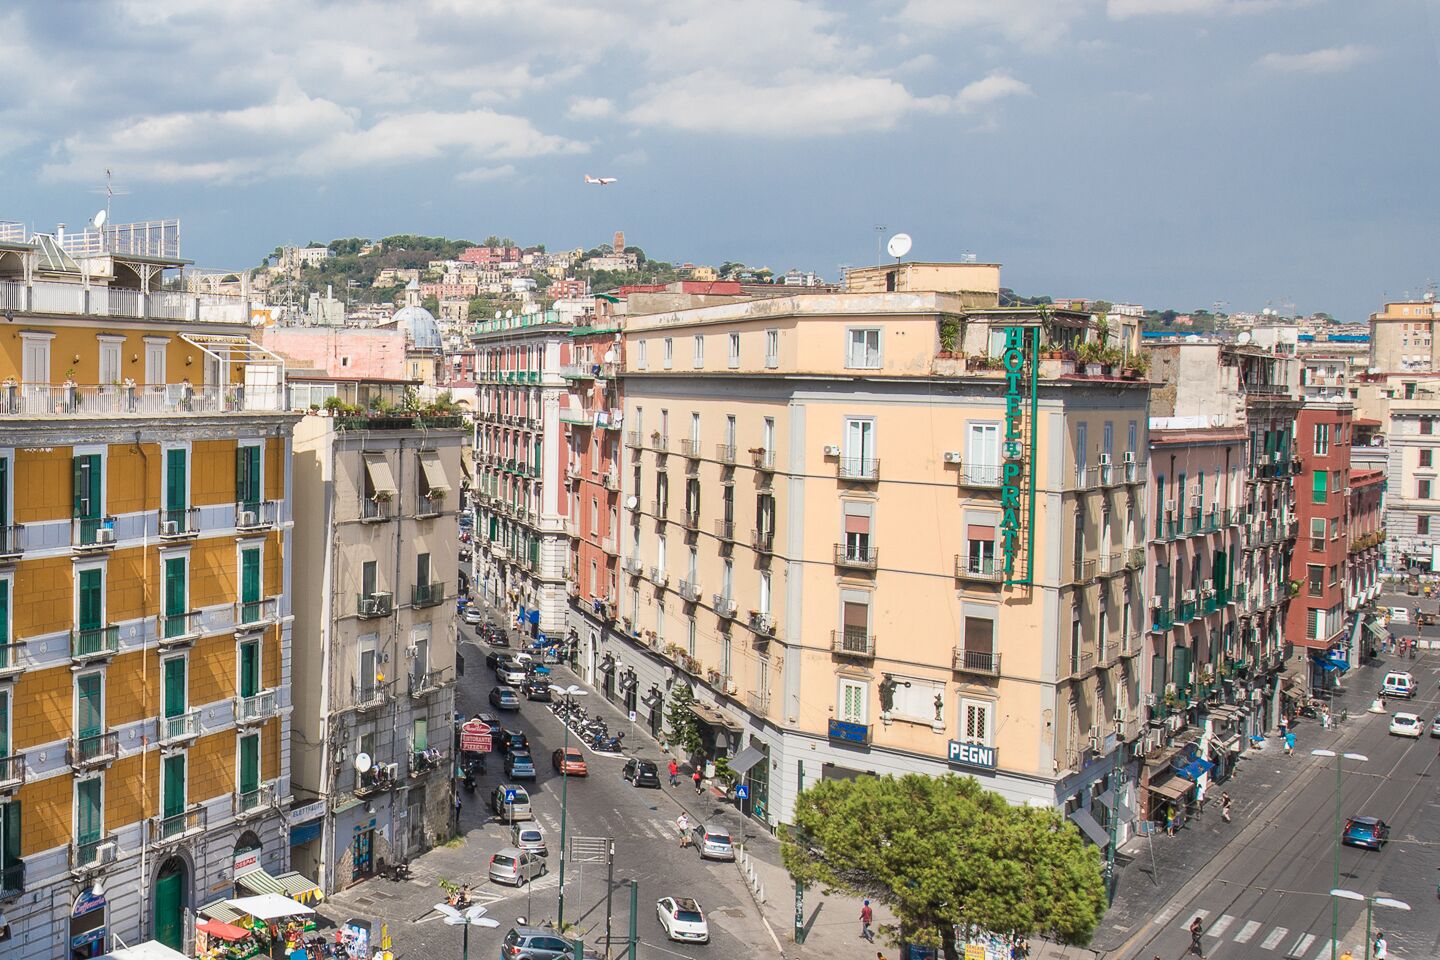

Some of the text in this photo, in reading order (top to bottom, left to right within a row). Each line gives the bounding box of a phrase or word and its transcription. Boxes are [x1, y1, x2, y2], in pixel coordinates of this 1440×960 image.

[1003, 327, 1024, 439] HOTEL
[1000, 463, 1021, 573] PRATI
[950, 742, 993, 766] PEGNI
